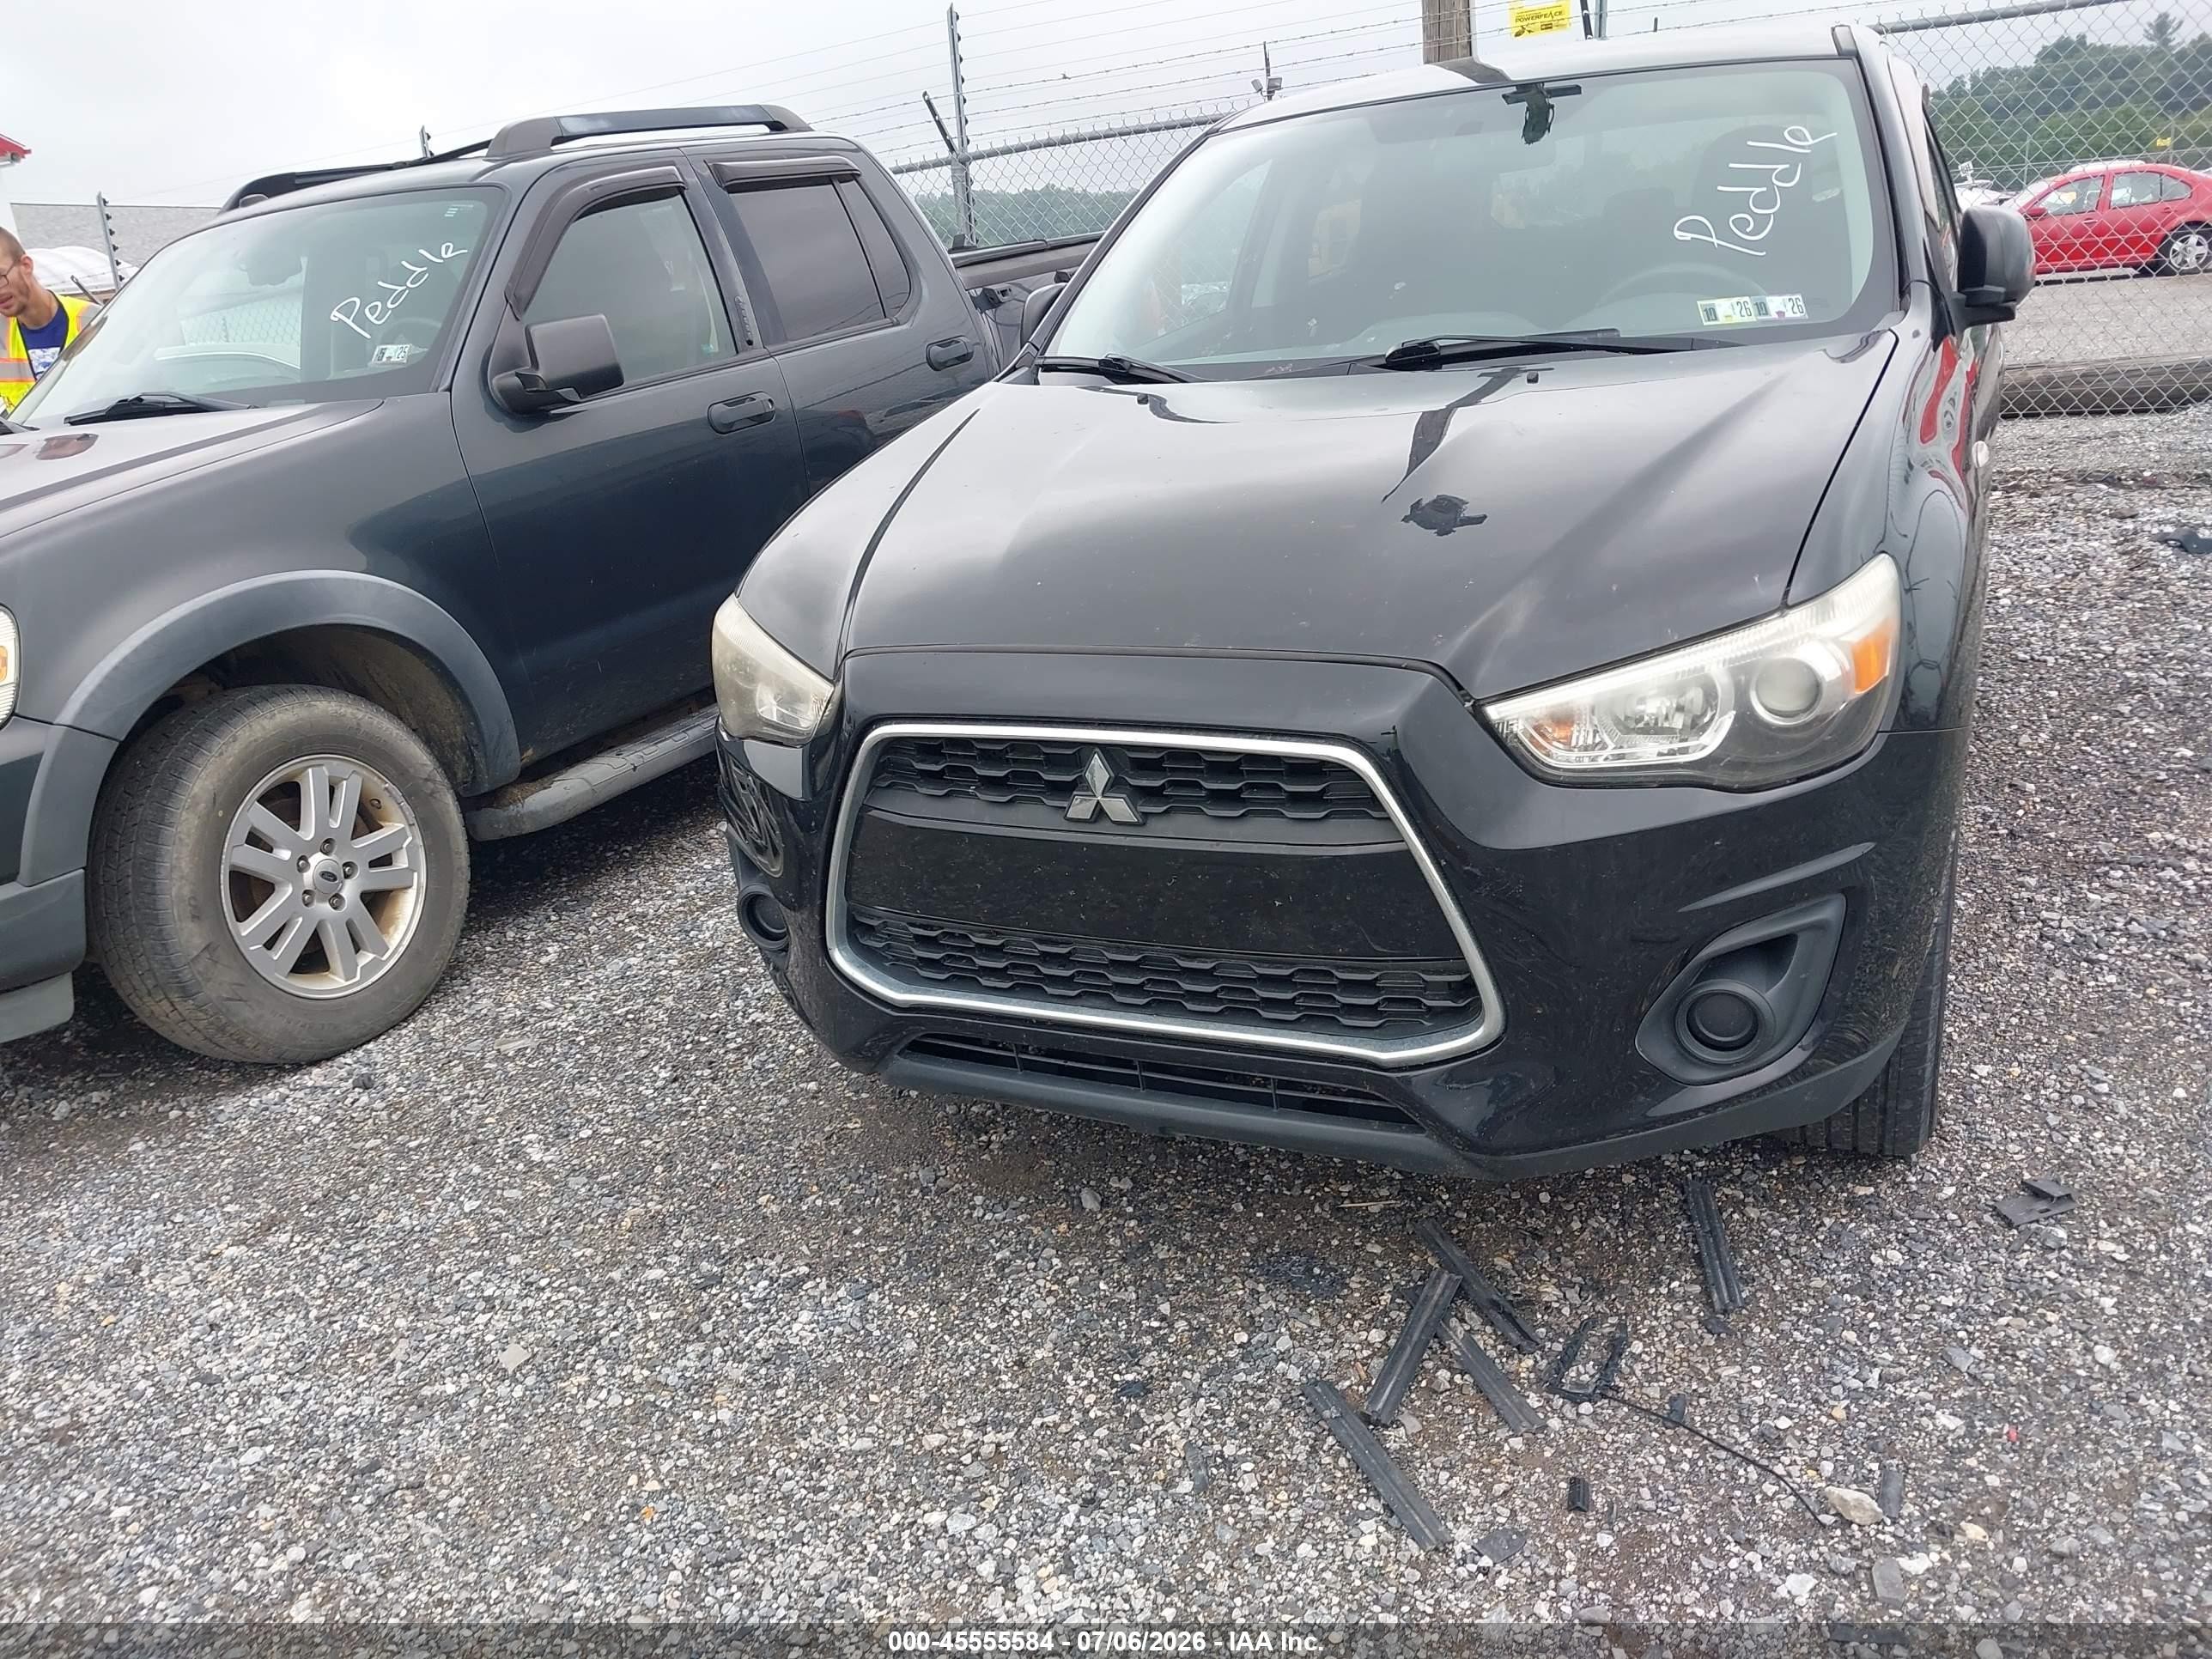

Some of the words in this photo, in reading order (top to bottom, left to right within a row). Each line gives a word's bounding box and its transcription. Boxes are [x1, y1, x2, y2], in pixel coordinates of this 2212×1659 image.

[1674, 125, 1838, 256] Peddle
[330, 242, 468, 339] Peddle
[1736, 301, 1753, 317] 26
[1788, 297, 1804, 314] 26
[397, 345, 409, 359] 25
